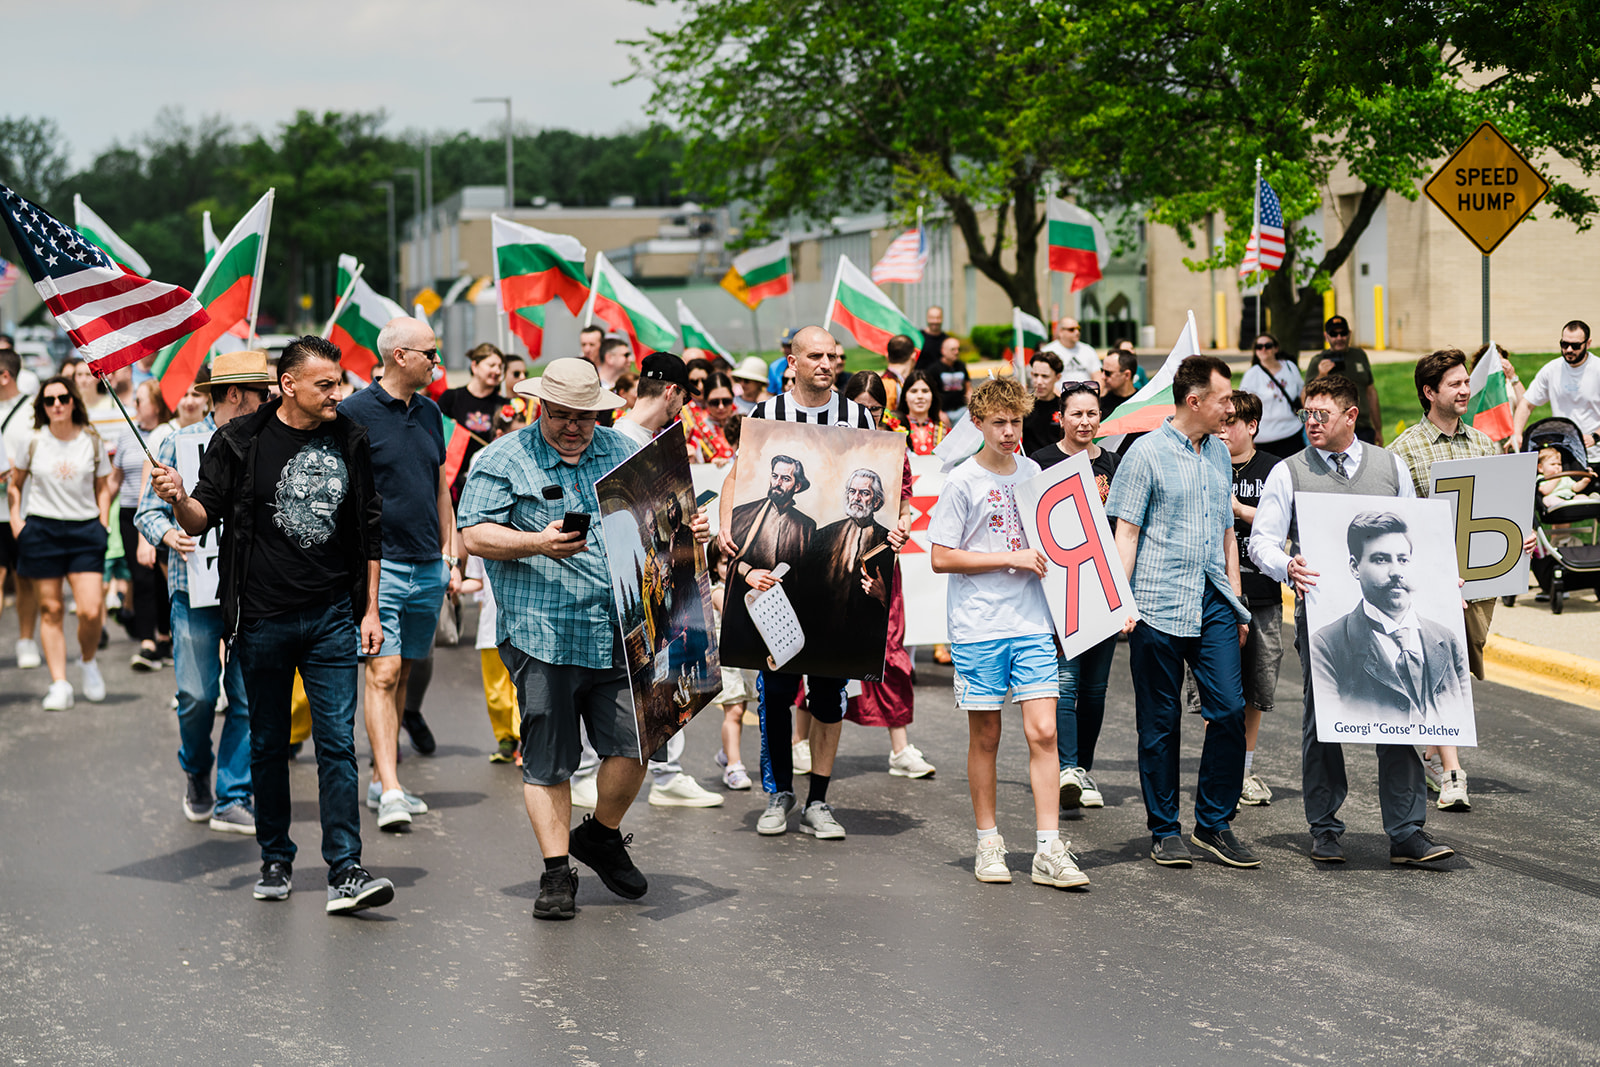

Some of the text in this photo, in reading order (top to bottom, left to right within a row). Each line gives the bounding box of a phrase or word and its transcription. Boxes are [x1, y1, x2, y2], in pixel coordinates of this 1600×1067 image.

[1455, 168, 1518, 186] SPEED
[1458, 192, 1516, 211] HUMP
[1240, 478, 1254, 498] the
[1036, 472, 1122, 638] Я
[1334, 721, 1371, 736] Georgi
[1418, 724, 1460, 736] Delchev
